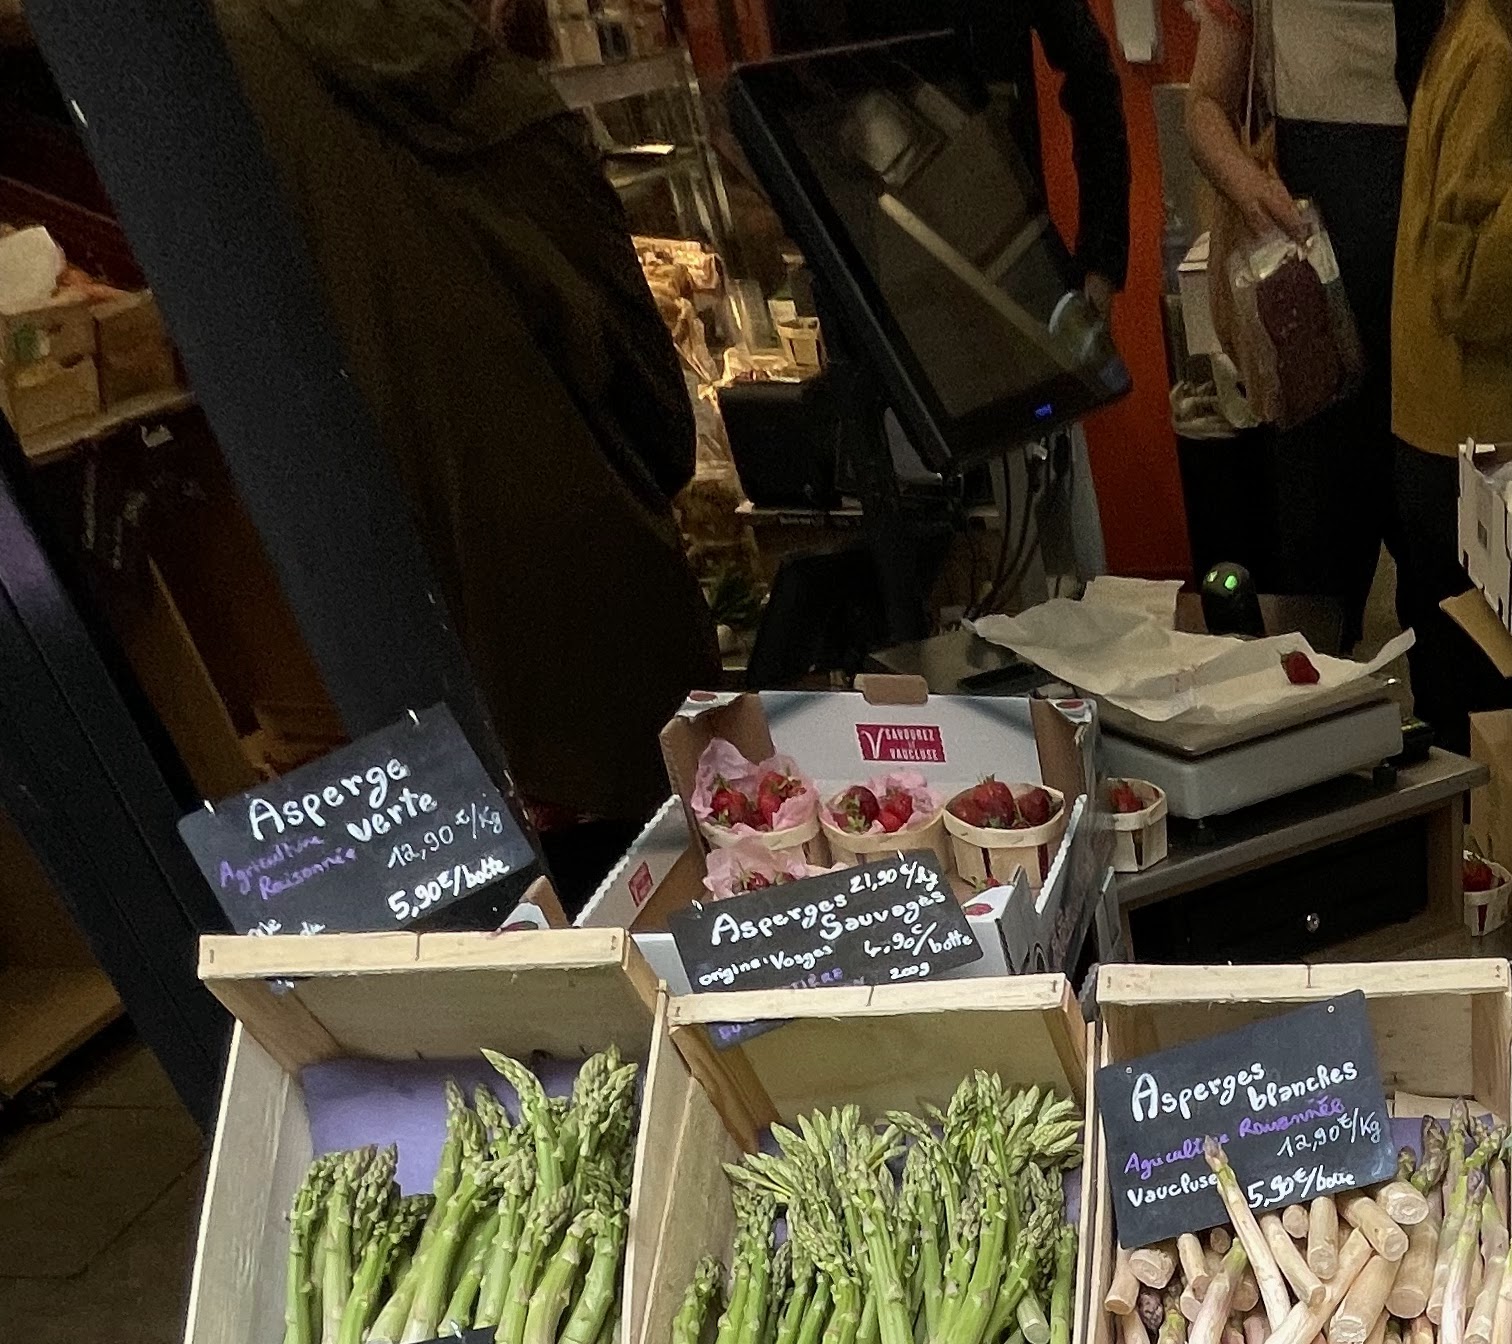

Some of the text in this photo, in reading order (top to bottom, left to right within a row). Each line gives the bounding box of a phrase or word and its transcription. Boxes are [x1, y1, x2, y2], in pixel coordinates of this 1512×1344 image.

[248, 758, 410, 841] Asperge
[347, 787, 438, 843] verte
[711, 893, 848, 946] Asperges
[1131, 1062, 1265, 1121] Asperges
[1248, 1062, 1358, 1111] blanches
[1127, 1172, 1220, 1208] Vaucluse
